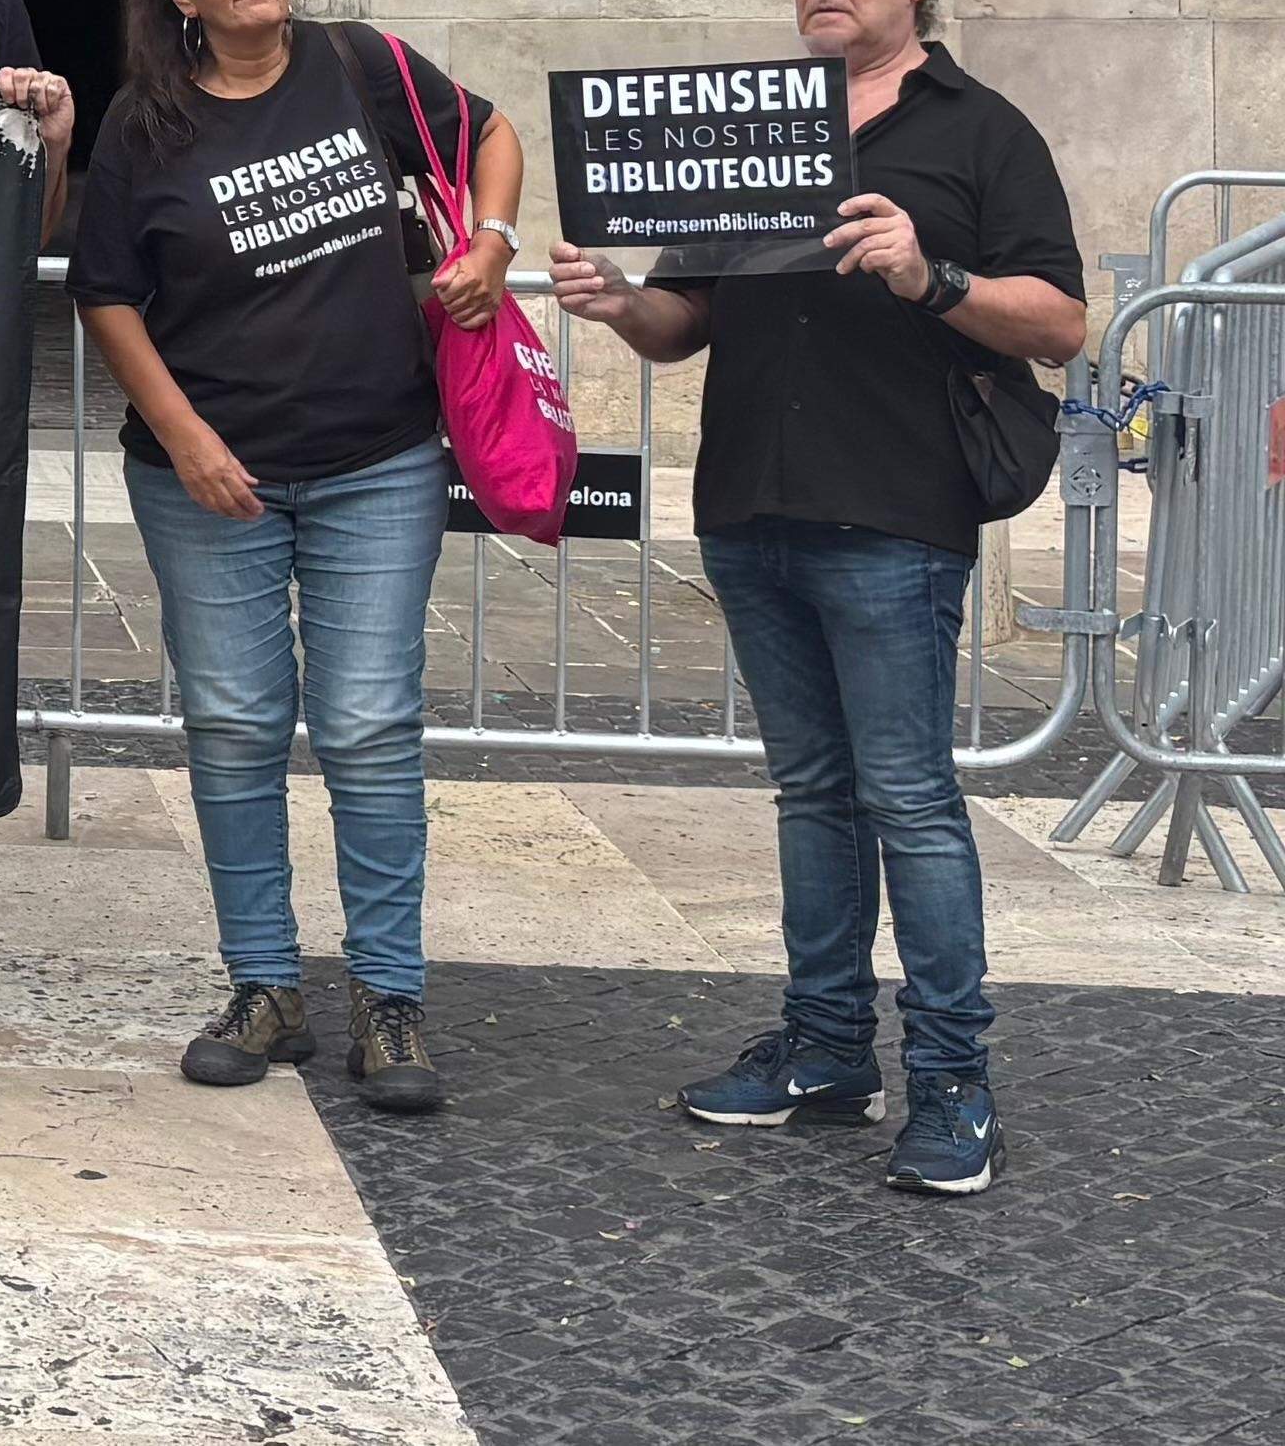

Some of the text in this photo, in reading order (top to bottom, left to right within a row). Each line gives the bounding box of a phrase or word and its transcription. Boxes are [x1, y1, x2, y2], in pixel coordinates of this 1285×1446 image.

[582, 67, 827, 118] DEFENSEM
[584, 120, 830, 152] LES NOSTRES
[209, 128, 367, 204] DEFENSEM
[586, 153, 833, 194] BIBLIOTEQUES
[221, 160, 377, 225] LES NOSTRES
[229, 181, 386, 254] BIBLIOTEQUES
[606, 212, 815, 237] #DefensemBibliosBcn
[566, 486, 632, 507] elona
